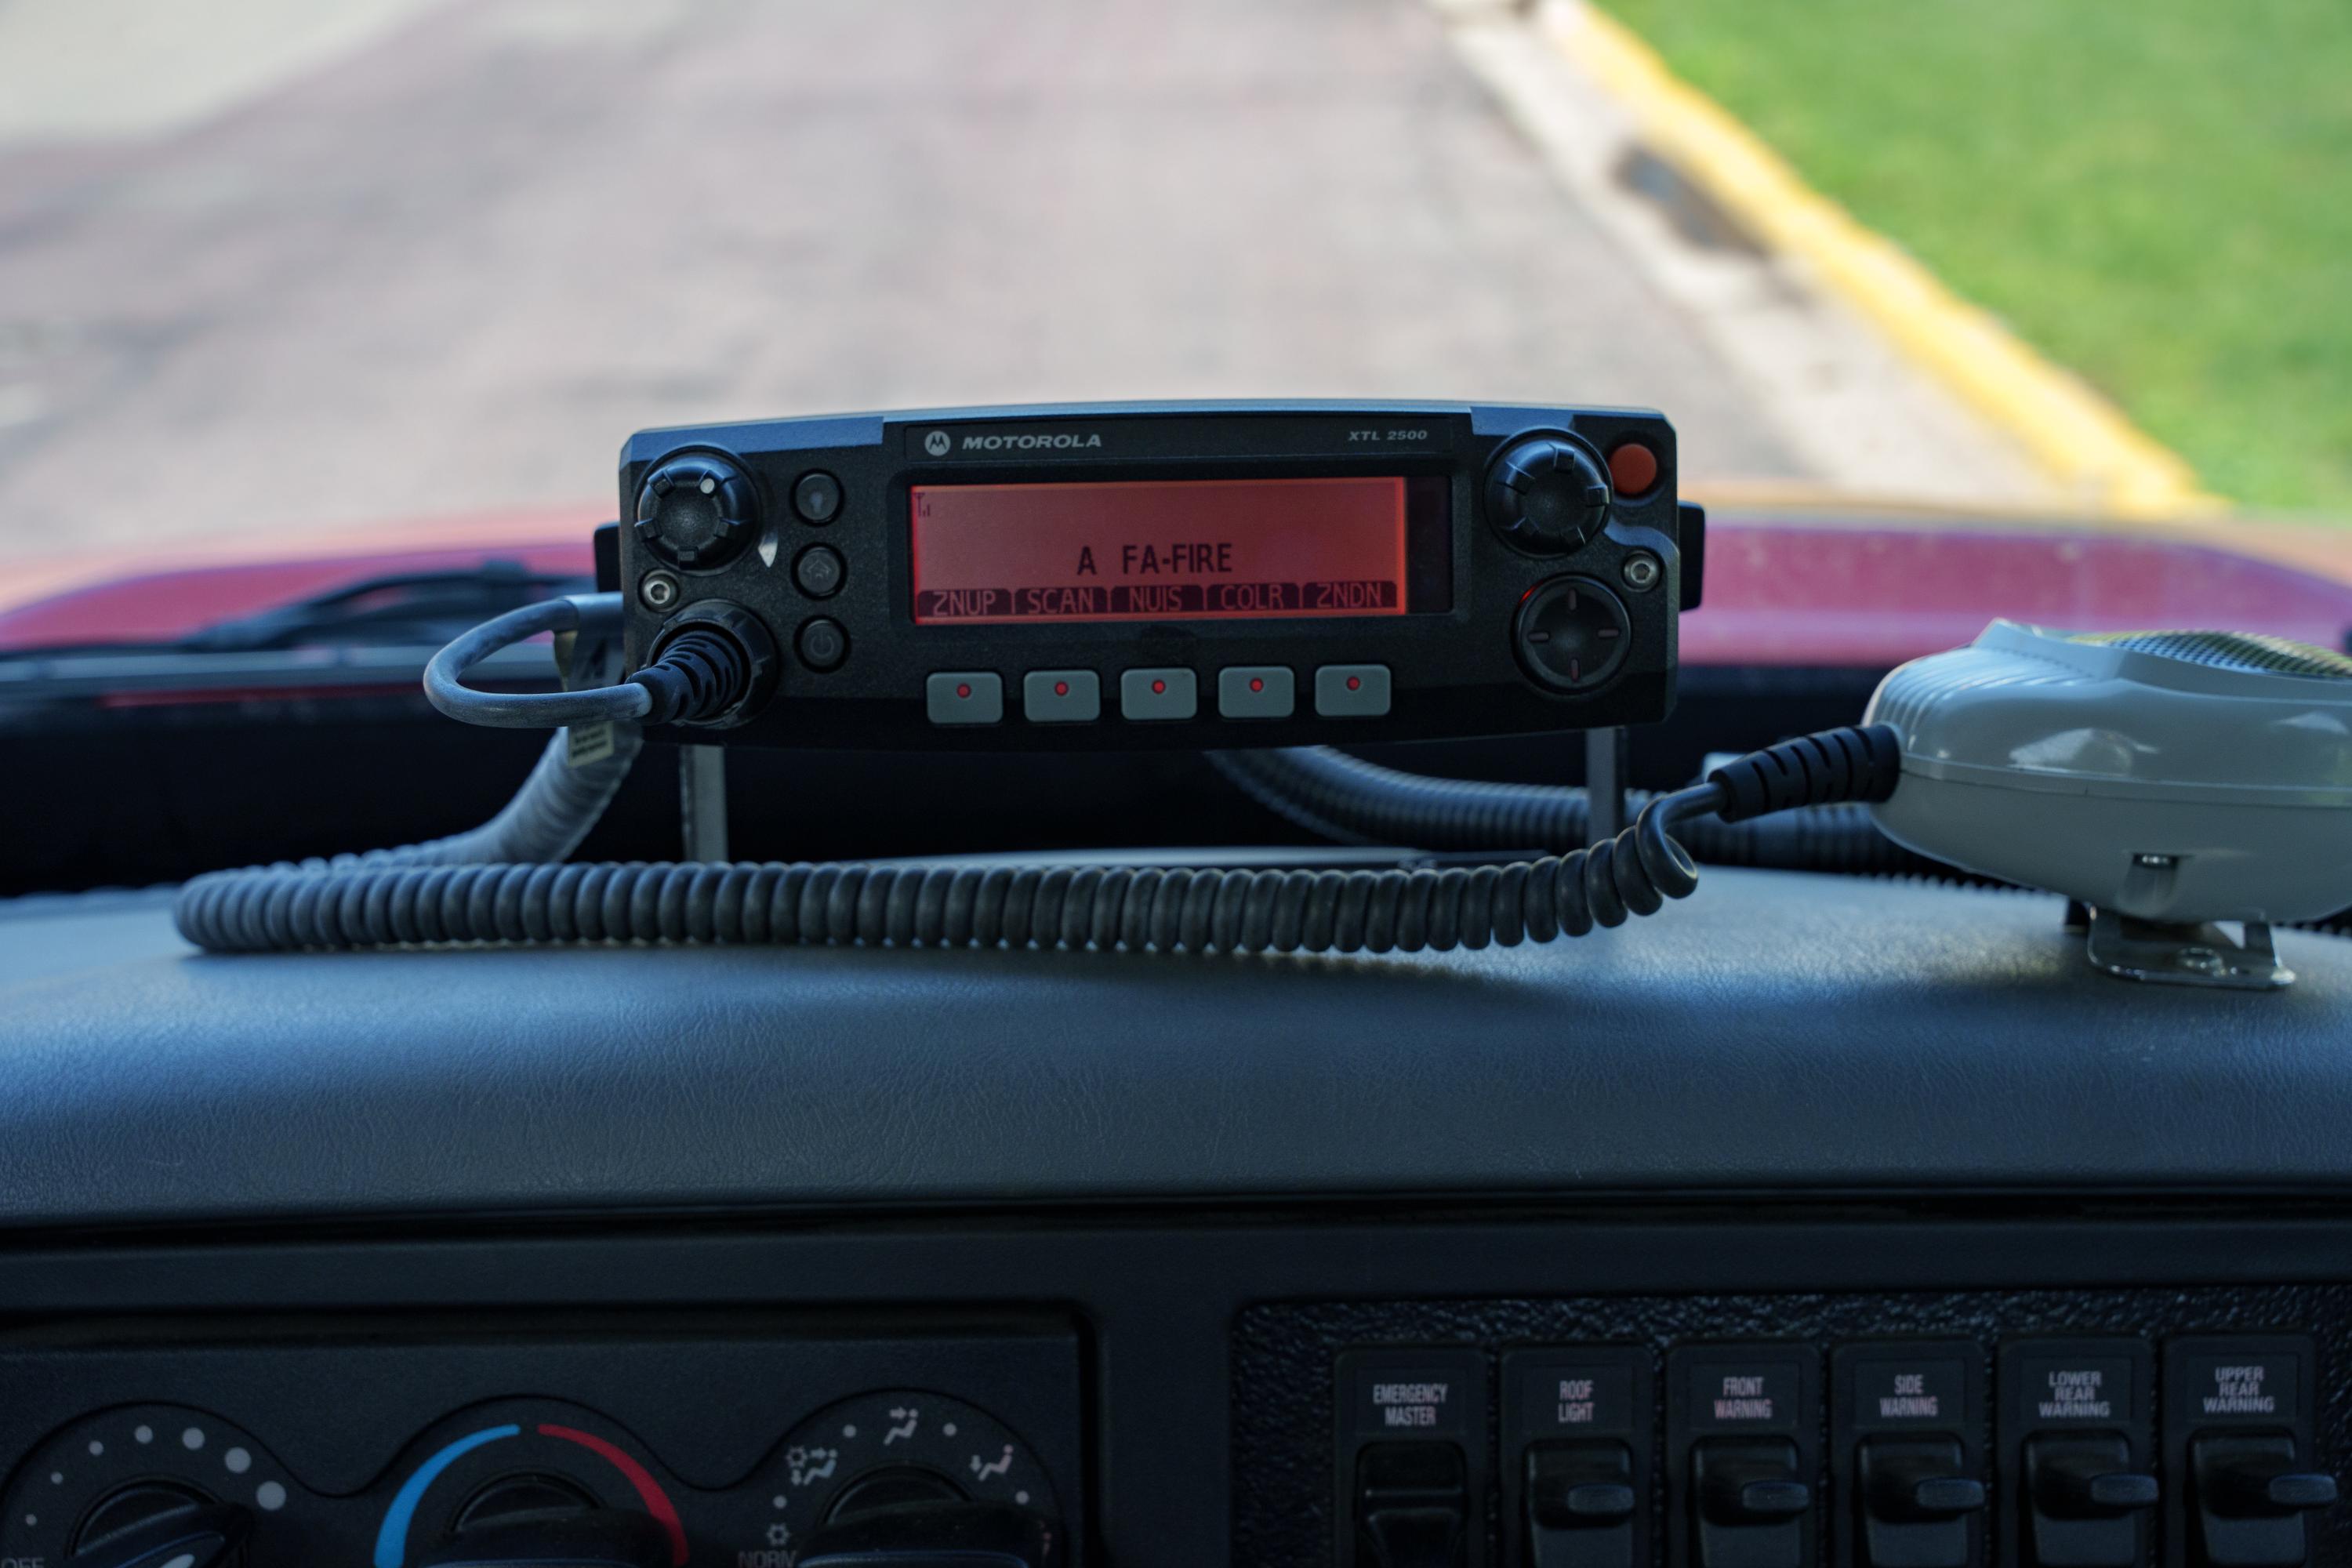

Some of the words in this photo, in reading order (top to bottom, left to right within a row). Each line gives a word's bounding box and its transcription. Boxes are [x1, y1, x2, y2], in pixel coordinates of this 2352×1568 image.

[962, 434, 1102, 450] MOTOROLA
[1348, 430, 1380, 441] XTL
[1386, 430, 1428, 441] 2500
[1077, 546, 1097, 575] A
[1123, 543, 1232, 574] FA-FIRE
[1027, 588, 1094, 614] SCAN
[1129, 586, 1182, 611] NUIS
[1221, 584, 1284, 610] COLR
[2049, 1370, 2103, 1388] LOWER
[2215, 1366, 2264, 1383] UPPER
[1374, 1383, 1448, 1404] EMERGENCY
[1559, 1380, 1593, 1400] ROOF
[1723, 1376, 1764, 1397] FRONT
[1894, 1374, 1924, 1396] SIDE
[2054, 1386, 2096, 1401] REAR
[2219, 1381, 2260, 1396] REAR
[1558, 1401, 1594, 1423] LIGHT
[1714, 1399, 1773, 1419] WARNING
[1879, 1396, 1939, 1417] WARNING
[2038, 1400, 2111, 1418] WARNING
[2203, 1395, 2274, 1413] WARNING
[1385, 1406, 1436, 1426] MASTER
